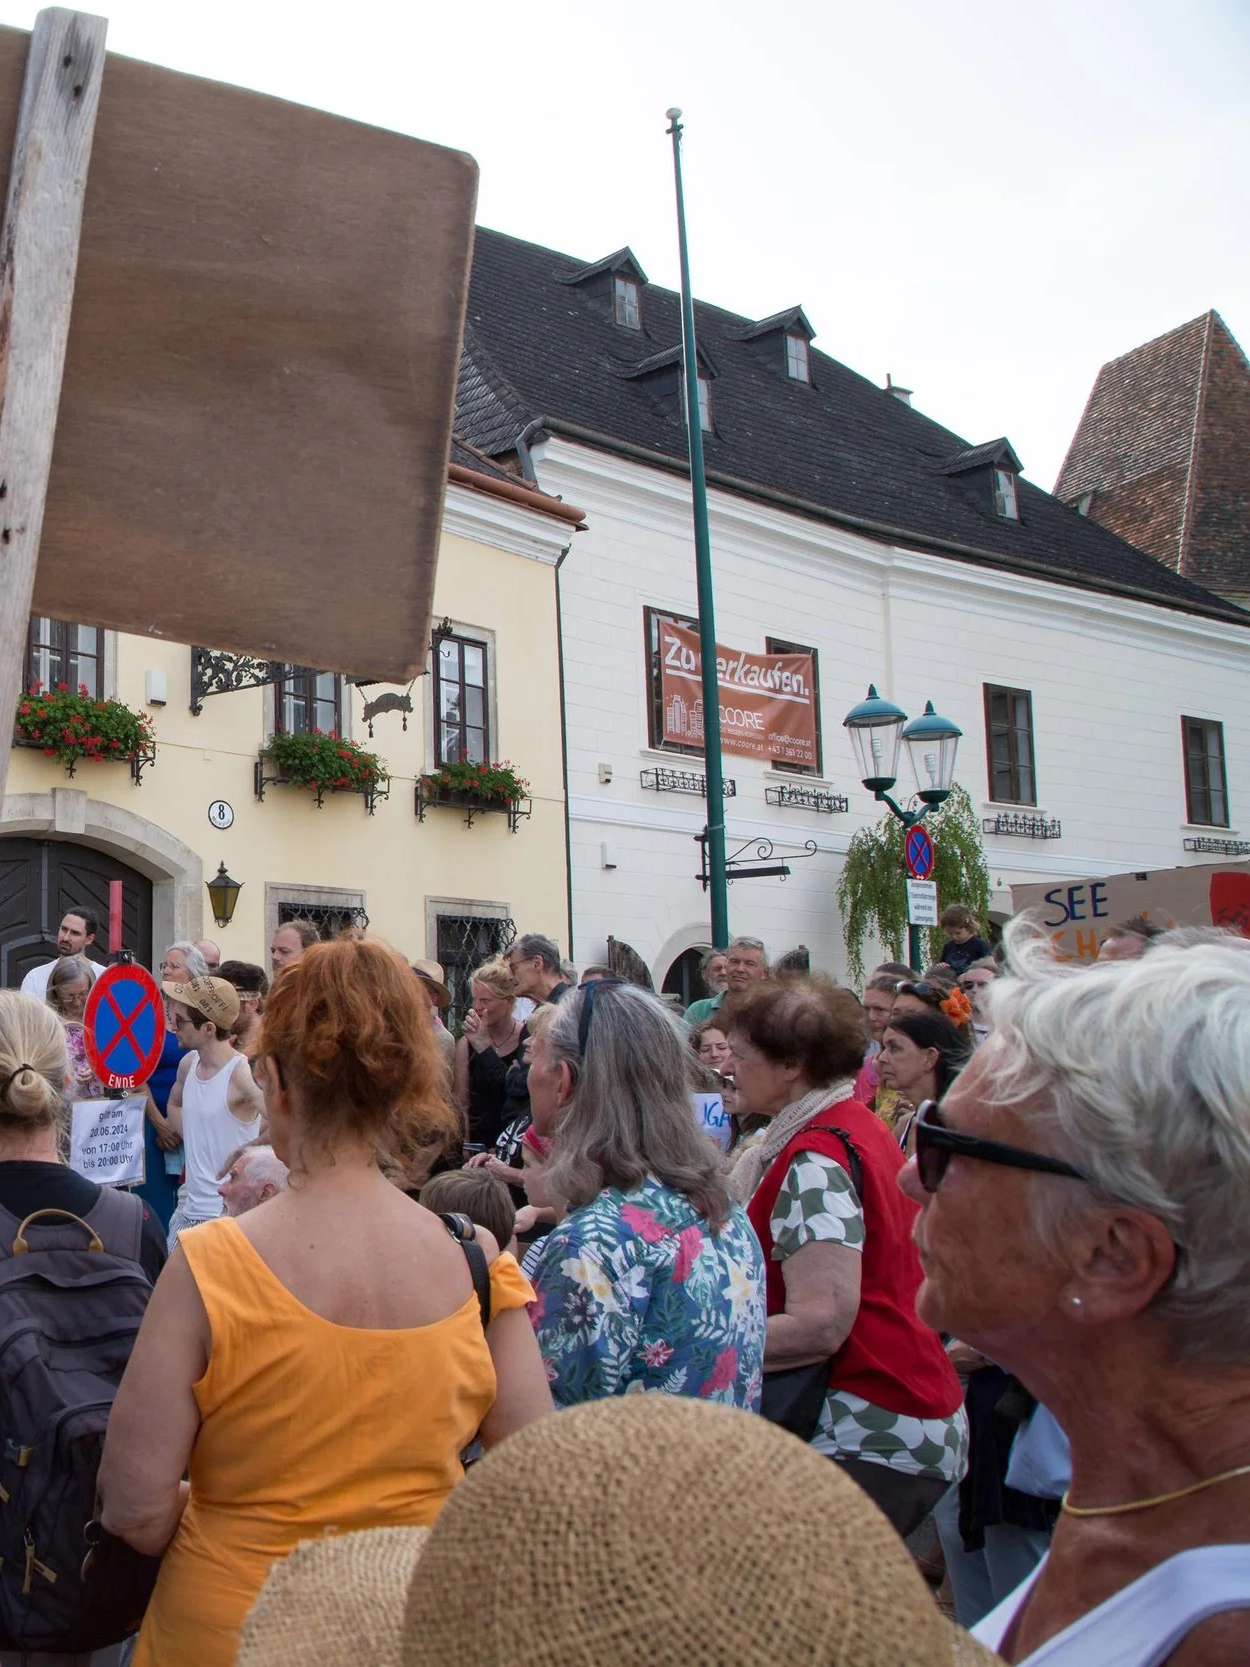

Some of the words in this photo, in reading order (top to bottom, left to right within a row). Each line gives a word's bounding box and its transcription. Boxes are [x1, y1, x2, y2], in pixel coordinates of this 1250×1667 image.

[664, 635, 696, 671] Zu
[699, 652, 810, 696] erkaufen.
[218, 803, 226, 821] 8
[1044, 881, 1109, 927] SEE
[108, 1073, 136, 1089] ENDE
[98, 1110, 111, 1122] gilt
[111, 1109, 123, 1118] am
[90, 1124, 129, 1138] 20.06.2024
[81, 1147, 97, 1155] von
[99, 1143, 120, 1153] 17:00
[120, 1140, 134, 1150] Uhr
[83, 1160, 96, 1169] bis
[97, 1156, 119, 1168] 20:00
[119, 1154, 134, 1164] Uhr
